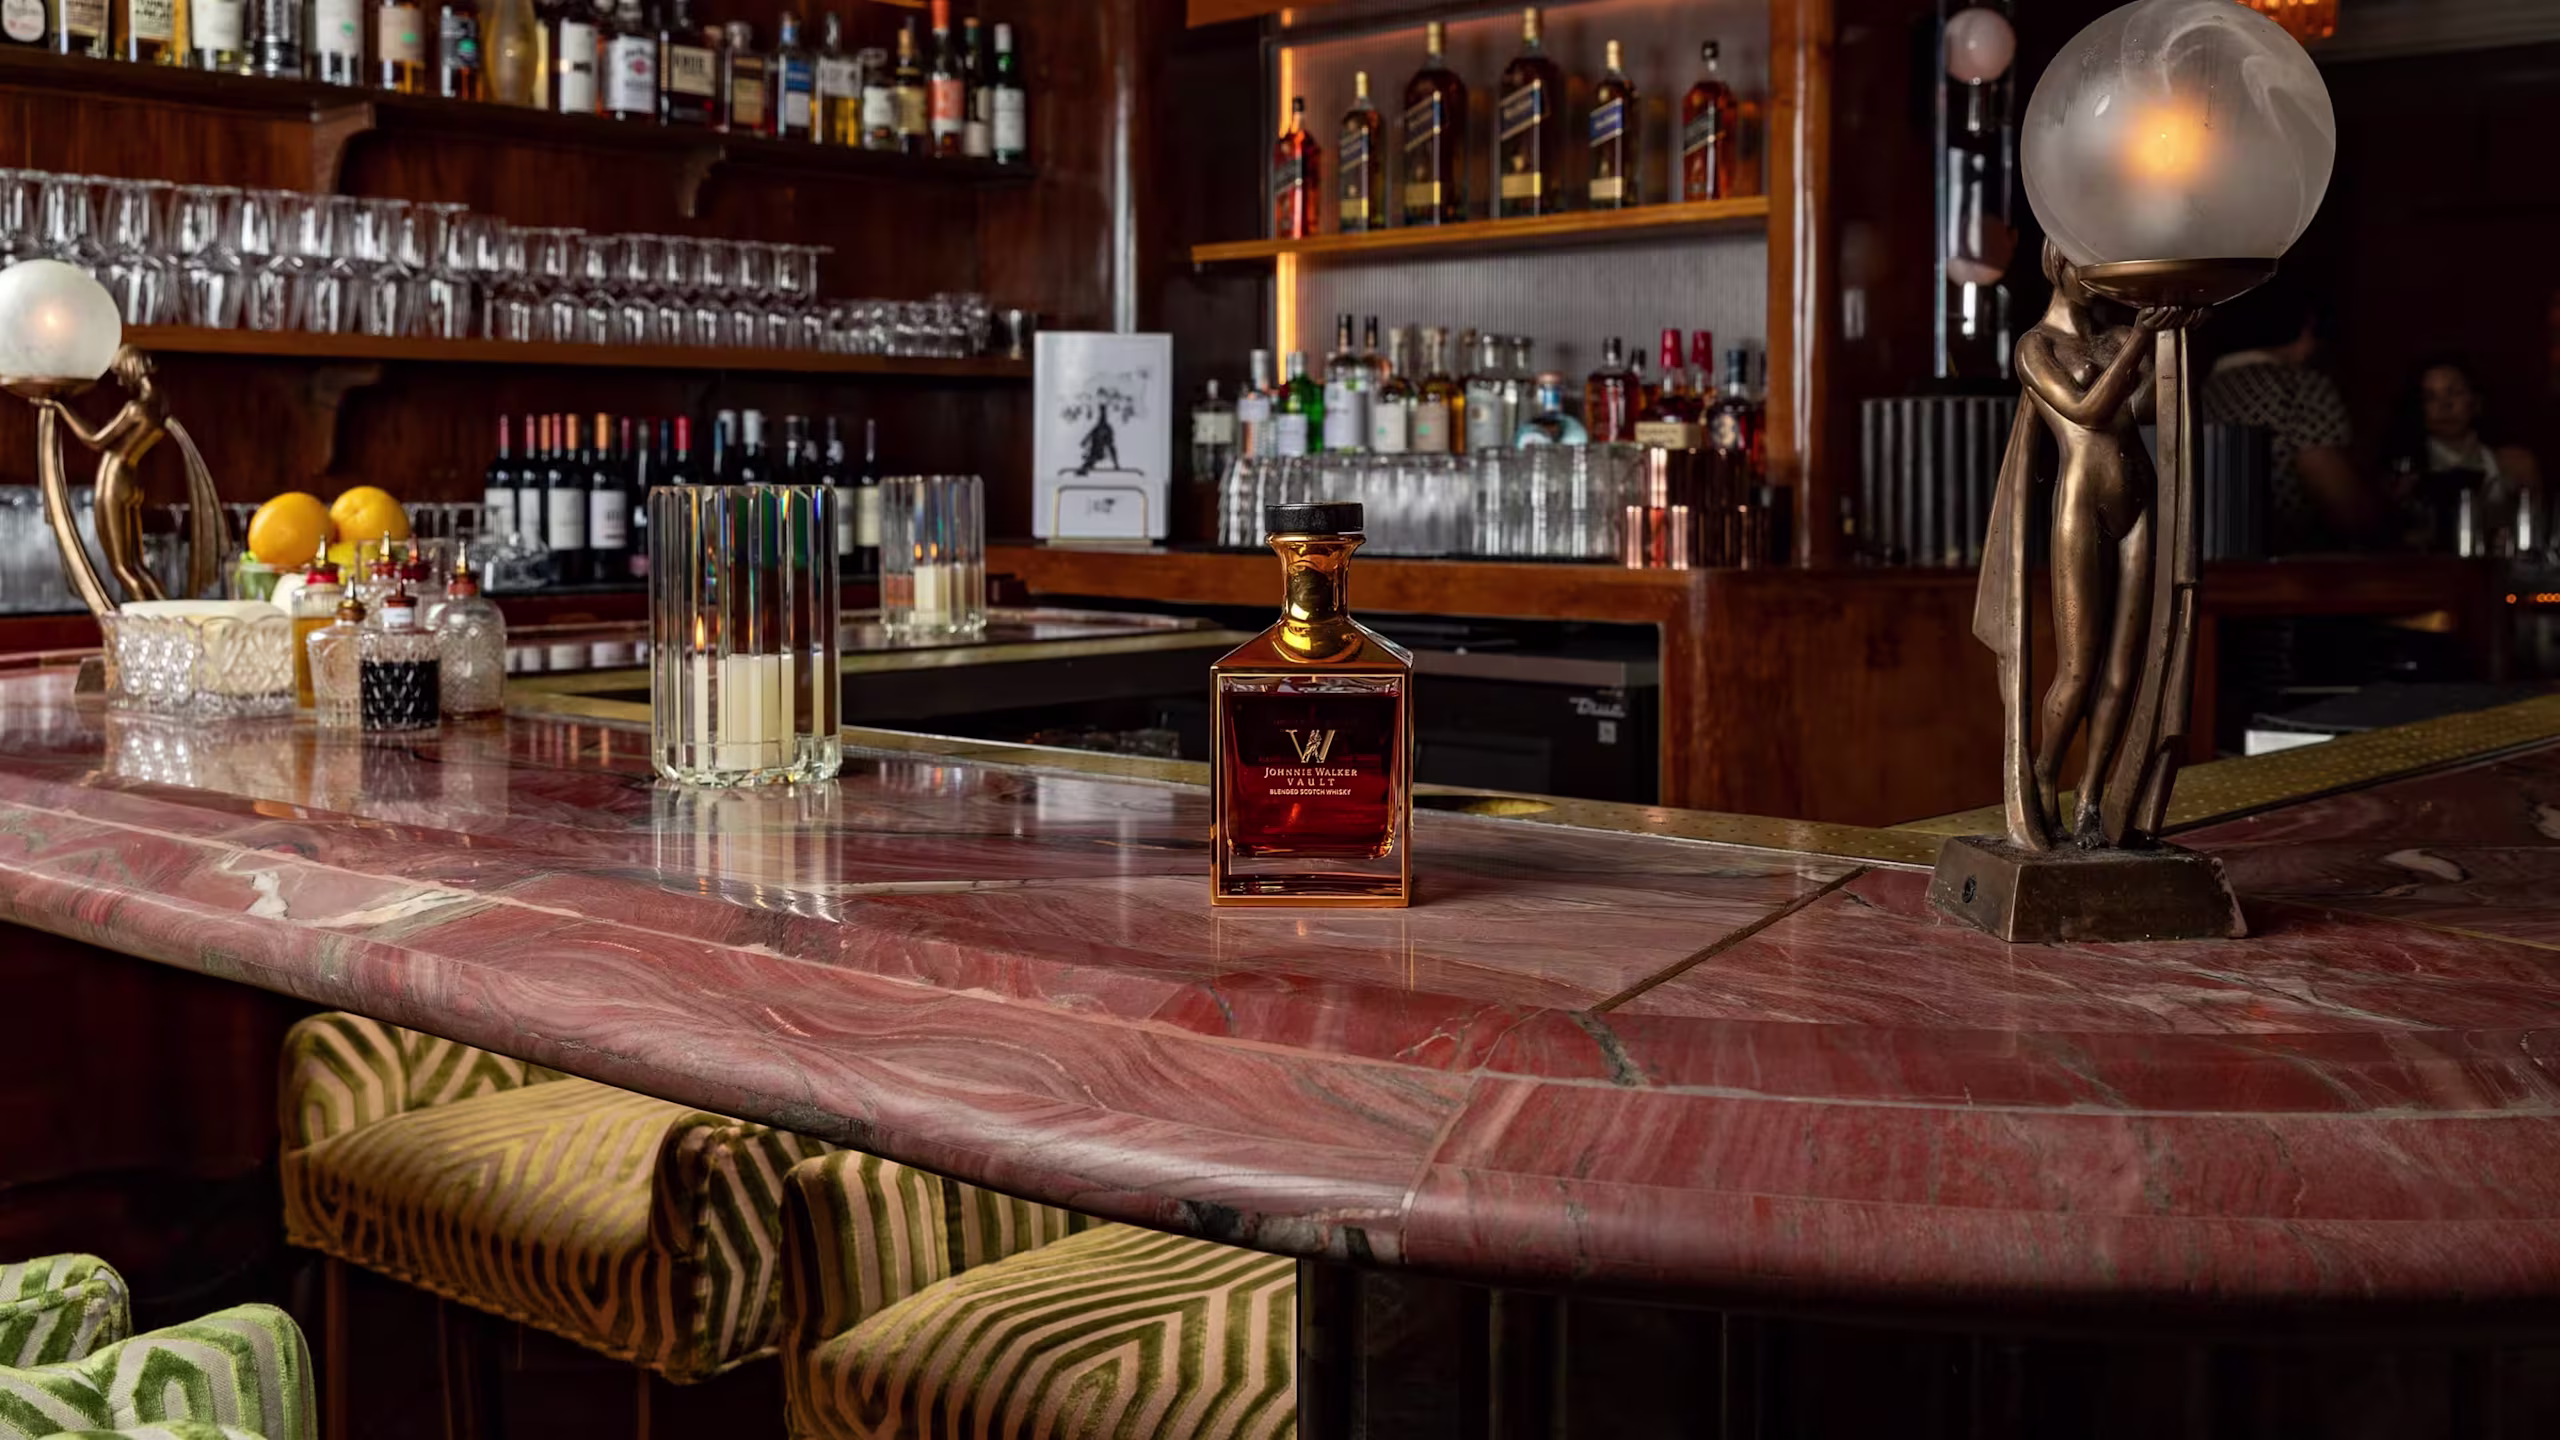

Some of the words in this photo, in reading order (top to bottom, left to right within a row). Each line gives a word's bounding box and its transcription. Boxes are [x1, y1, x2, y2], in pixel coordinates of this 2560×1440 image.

[1264, 767, 1312, 778] JOHNNIE
[1315, 767, 1358, 777] WALKER
[1287, 778, 1335, 786] VAULT
[1269, 788, 1299, 796] BLENDED
[1300, 788, 1325, 796] SCOTCH
[1325, 788, 1351, 796] WHISKY
